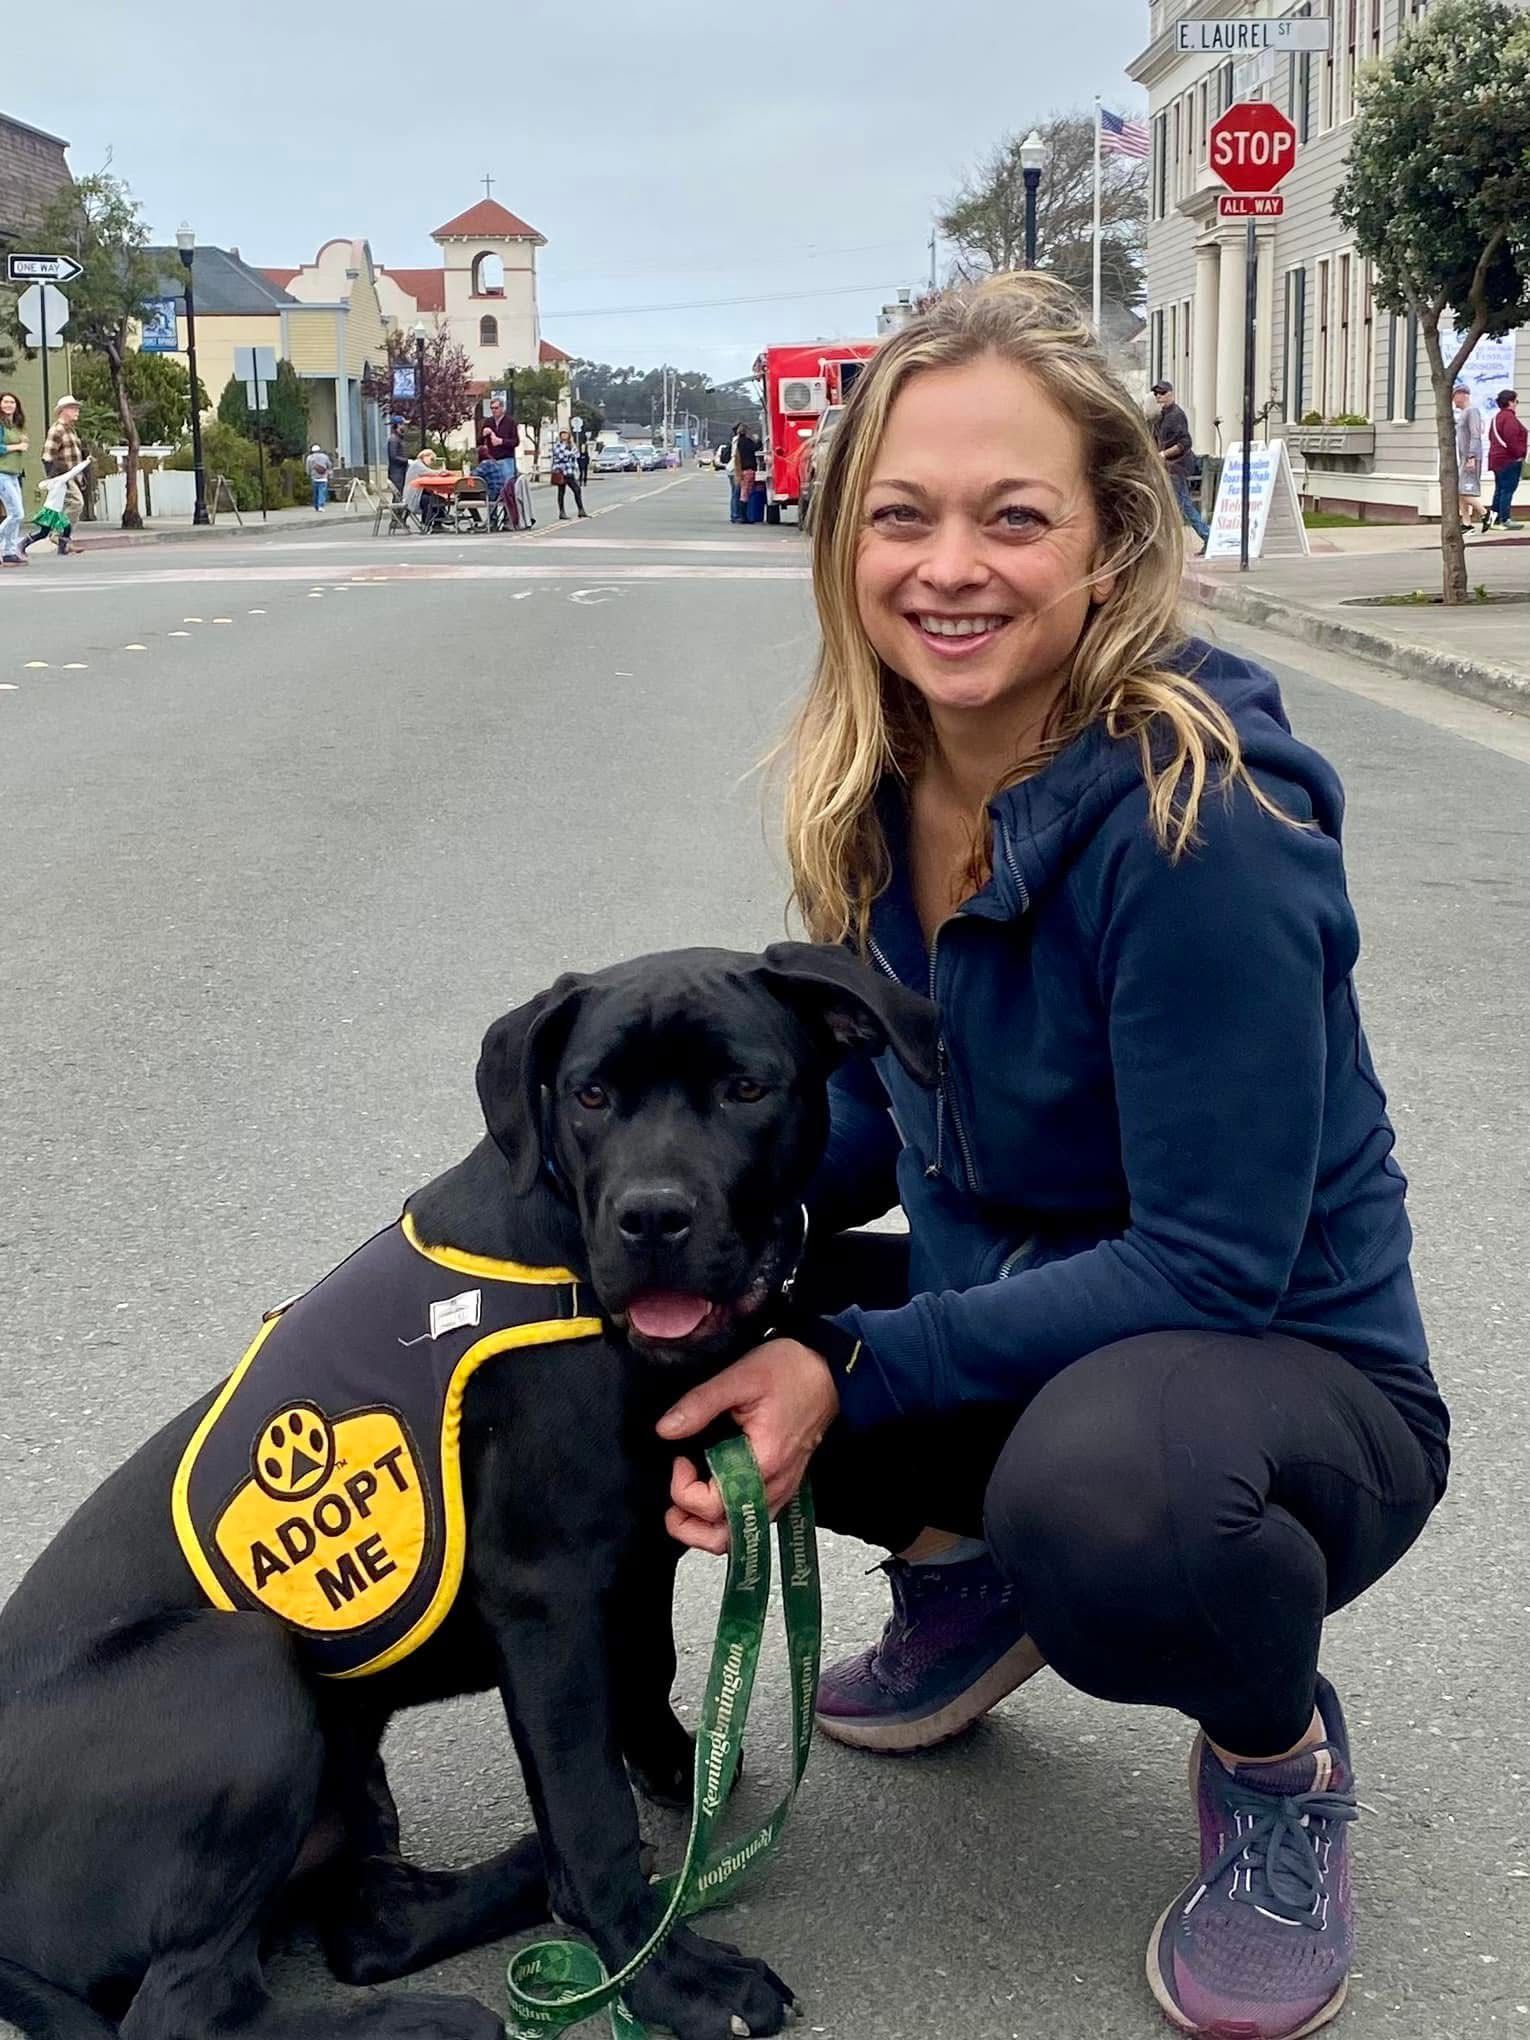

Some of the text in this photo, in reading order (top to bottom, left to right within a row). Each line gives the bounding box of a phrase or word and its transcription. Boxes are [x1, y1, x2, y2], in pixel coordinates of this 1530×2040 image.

[1180, 22, 1292, 49] E. LAUREL ST
[1214, 131, 1292, 166] STOP
[1223, 199, 1280, 214] ALL WAY
[16, 262, 60, 273] ONE WAY
[250, 1445, 409, 1591] ADOPT
[315, 1532, 398, 1612] ME
[697, 1824, 773, 1892] Remington
